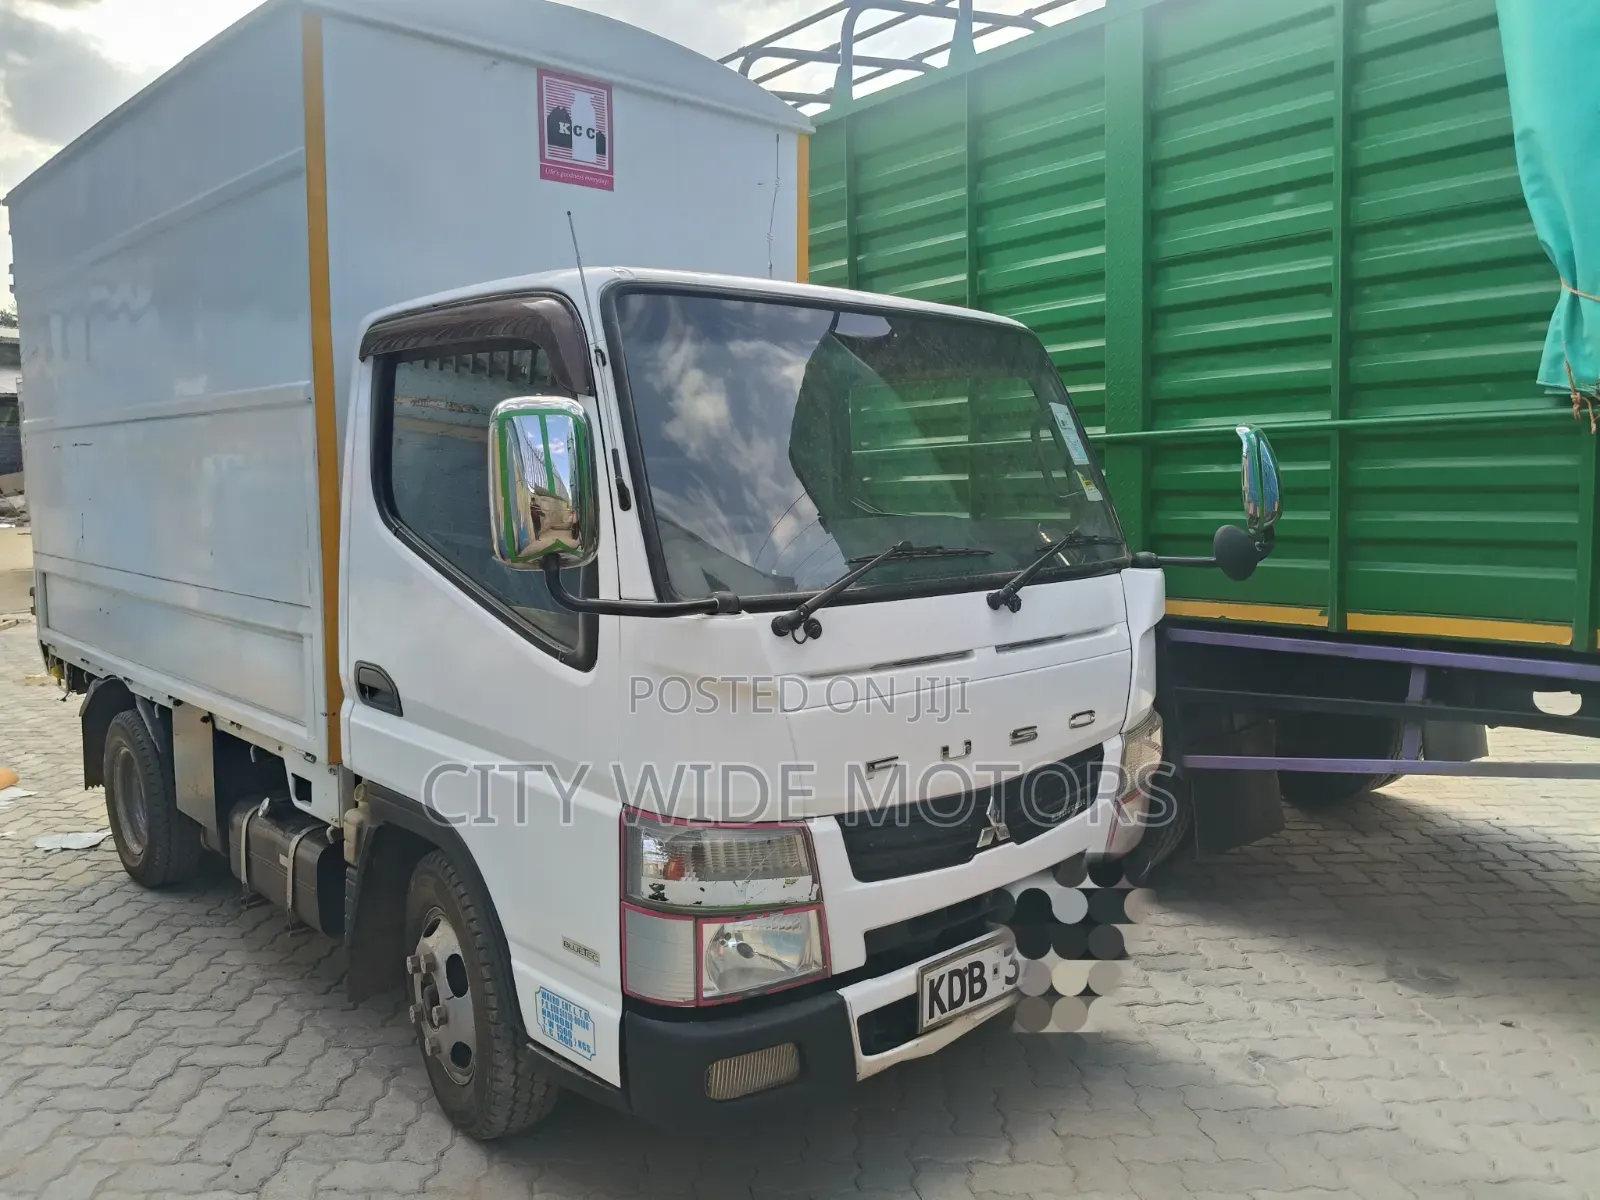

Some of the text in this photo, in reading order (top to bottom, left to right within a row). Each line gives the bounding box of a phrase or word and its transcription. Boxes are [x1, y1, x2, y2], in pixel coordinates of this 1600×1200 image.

[559, 121, 596, 139] KCC
[560, 171, 584, 181] goodness
[866, 709, 1096, 779] FUSO
[928, 960, 988, 1020] KDB
[541, 1007, 573, 1031] NAIROBI
